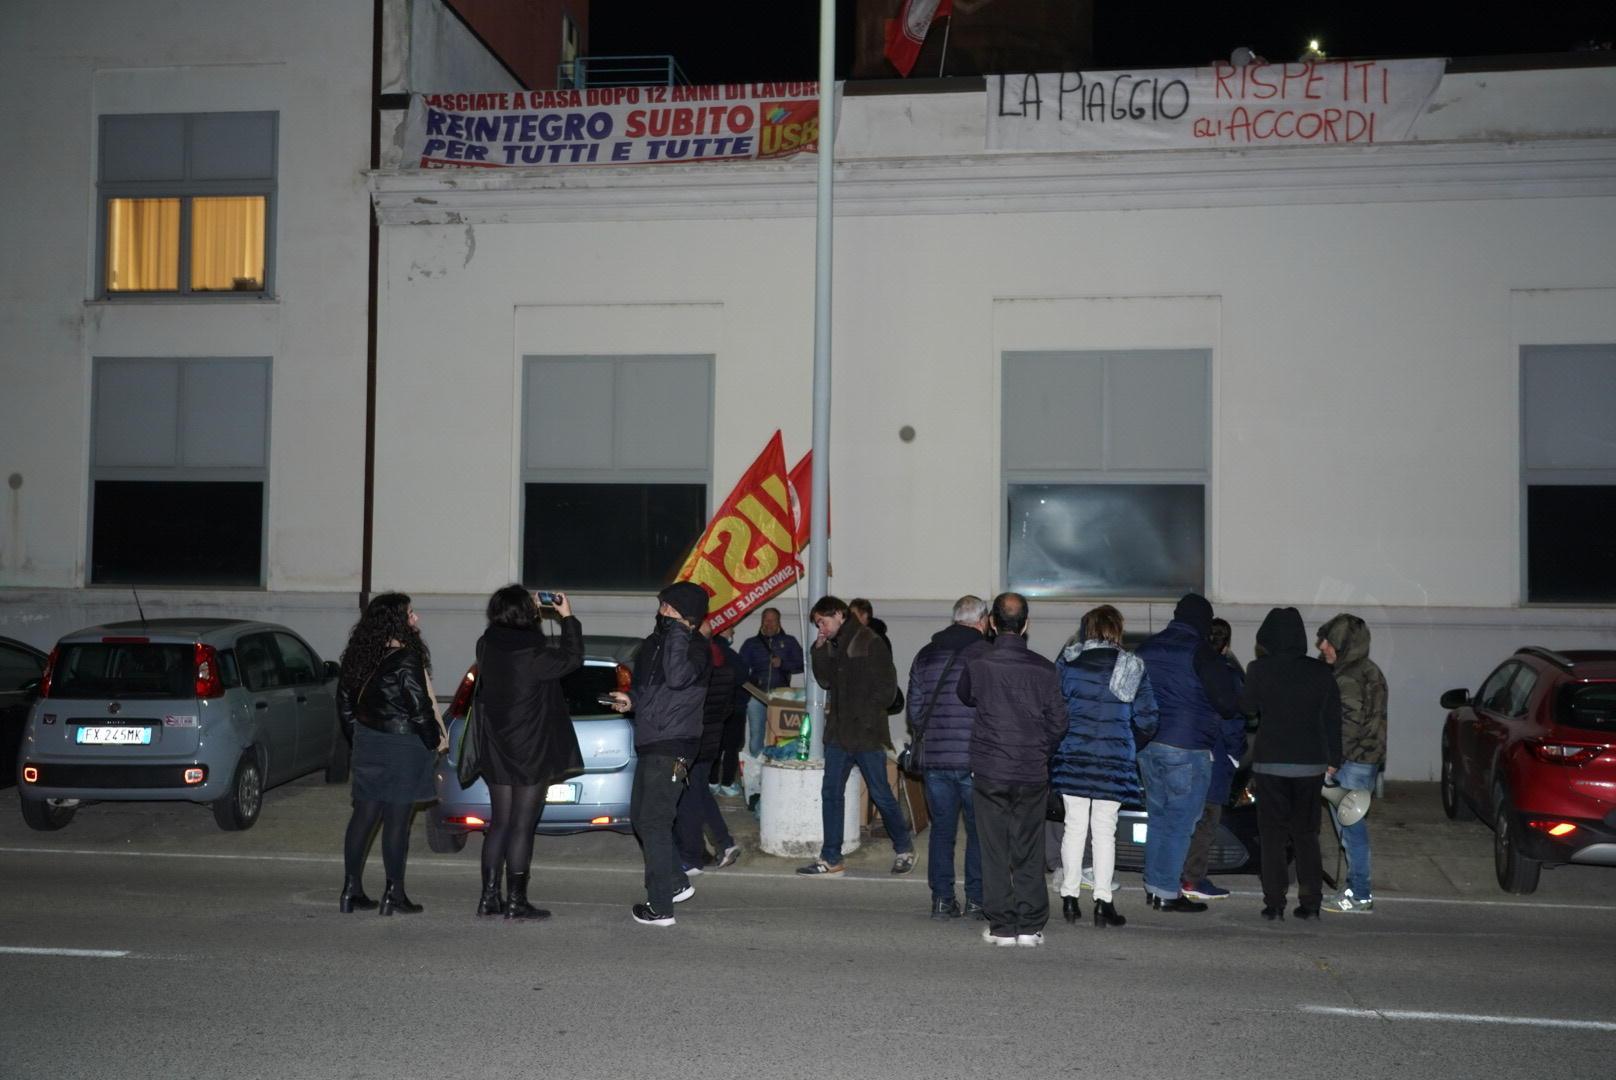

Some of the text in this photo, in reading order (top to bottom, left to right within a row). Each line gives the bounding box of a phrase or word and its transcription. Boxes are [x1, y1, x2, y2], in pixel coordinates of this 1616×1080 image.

[513, 92, 526, 110] A
[531, 90, 582, 109] CASA
[587, 87, 640, 106] DOPO
[644, 87, 667, 103] 12
[671, 85, 719, 102] ANNI
[725, 84, 746, 100] DI
[751, 82, 820, 98] LAVOR
[998, 71, 1190, 123] LA PIAGGIO
[1215, 59, 1388, 104] RISPETTI
[426, 105, 754, 142] REINTEGRO SUBITO
[762, 117, 819, 154] USB
[1225, 106, 1375, 143] ACCORDI
[422, 136, 753, 164] PER TUTTI E TUTTE
[783, 712, 801, 728] VA
